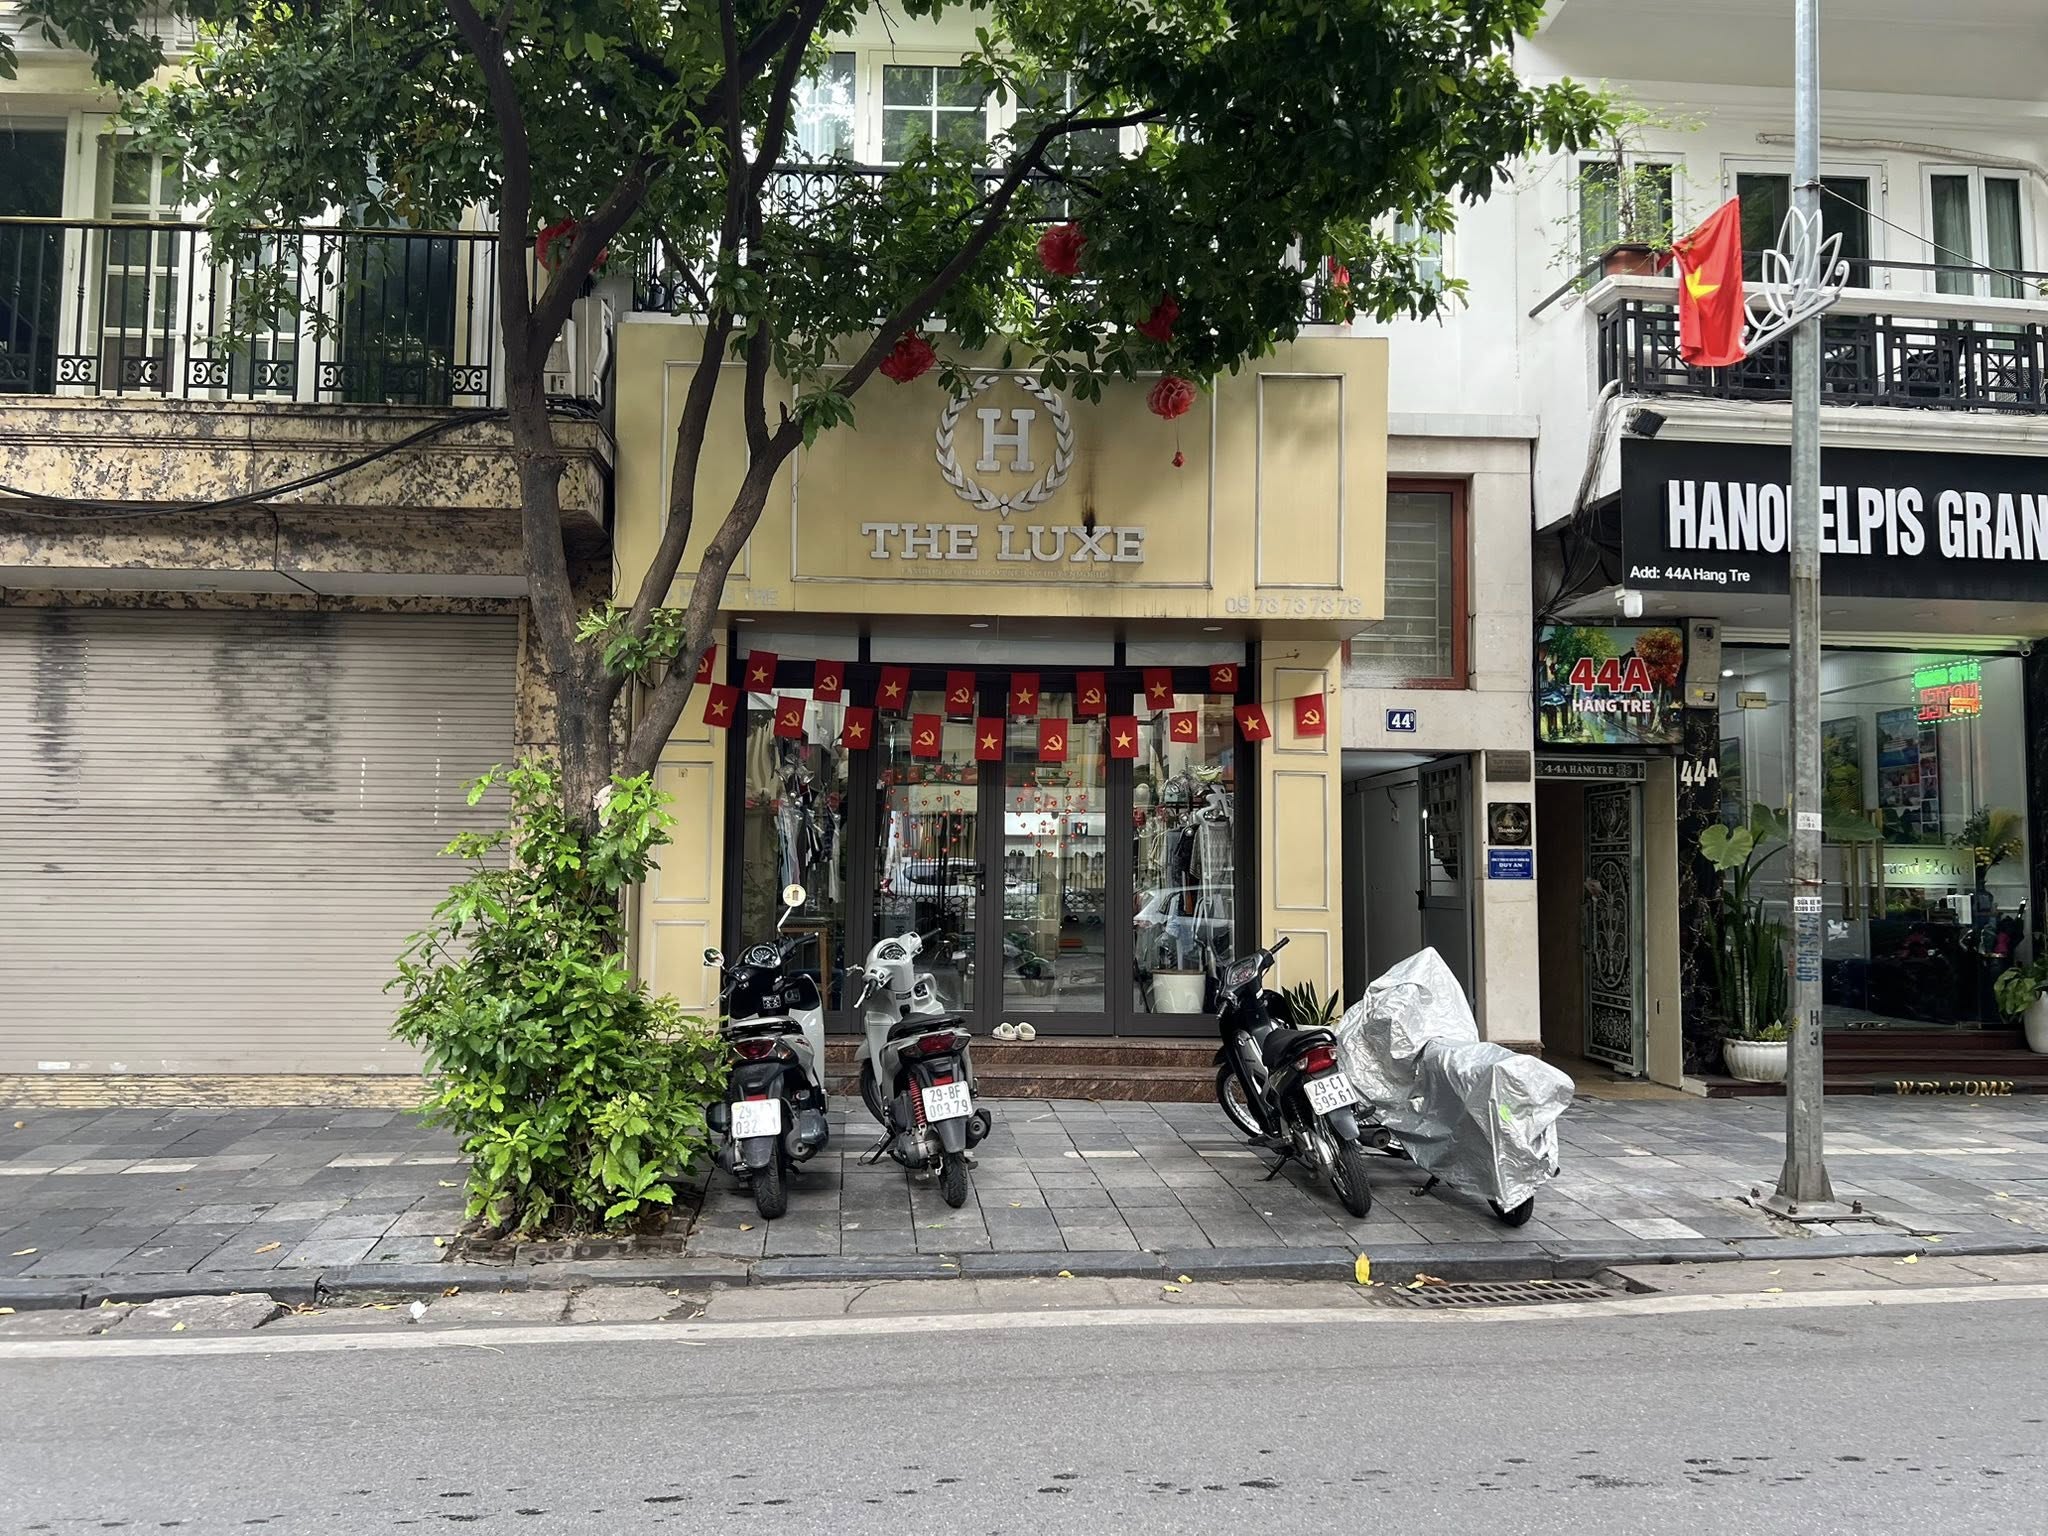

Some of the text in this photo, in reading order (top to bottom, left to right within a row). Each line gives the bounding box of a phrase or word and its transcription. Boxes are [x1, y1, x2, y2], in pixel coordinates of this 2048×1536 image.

[976, 408, 1035, 472] H
[1819, 486, 1925, 556] ELPIS
[1938, 489, 2048, 561] GRAN
[861, 523, 1145, 562] THE LUXE
[1629, 566, 1750, 584] Add: 44A Hang Tre
[1569, 657, 1654, 693] 44A
[1620, 699, 1652, 713] TRE
[1544, 765, 1568, 774] 44A
[1597, 765, 1615, 775] TRE
[1680, 757, 1719, 787] 44A
[930, 1084, 961, 1103] 29-BF
[1313, 1075, 1344, 1096] 29-C1
[1894, 1080, 2014, 1097] WELCOME
